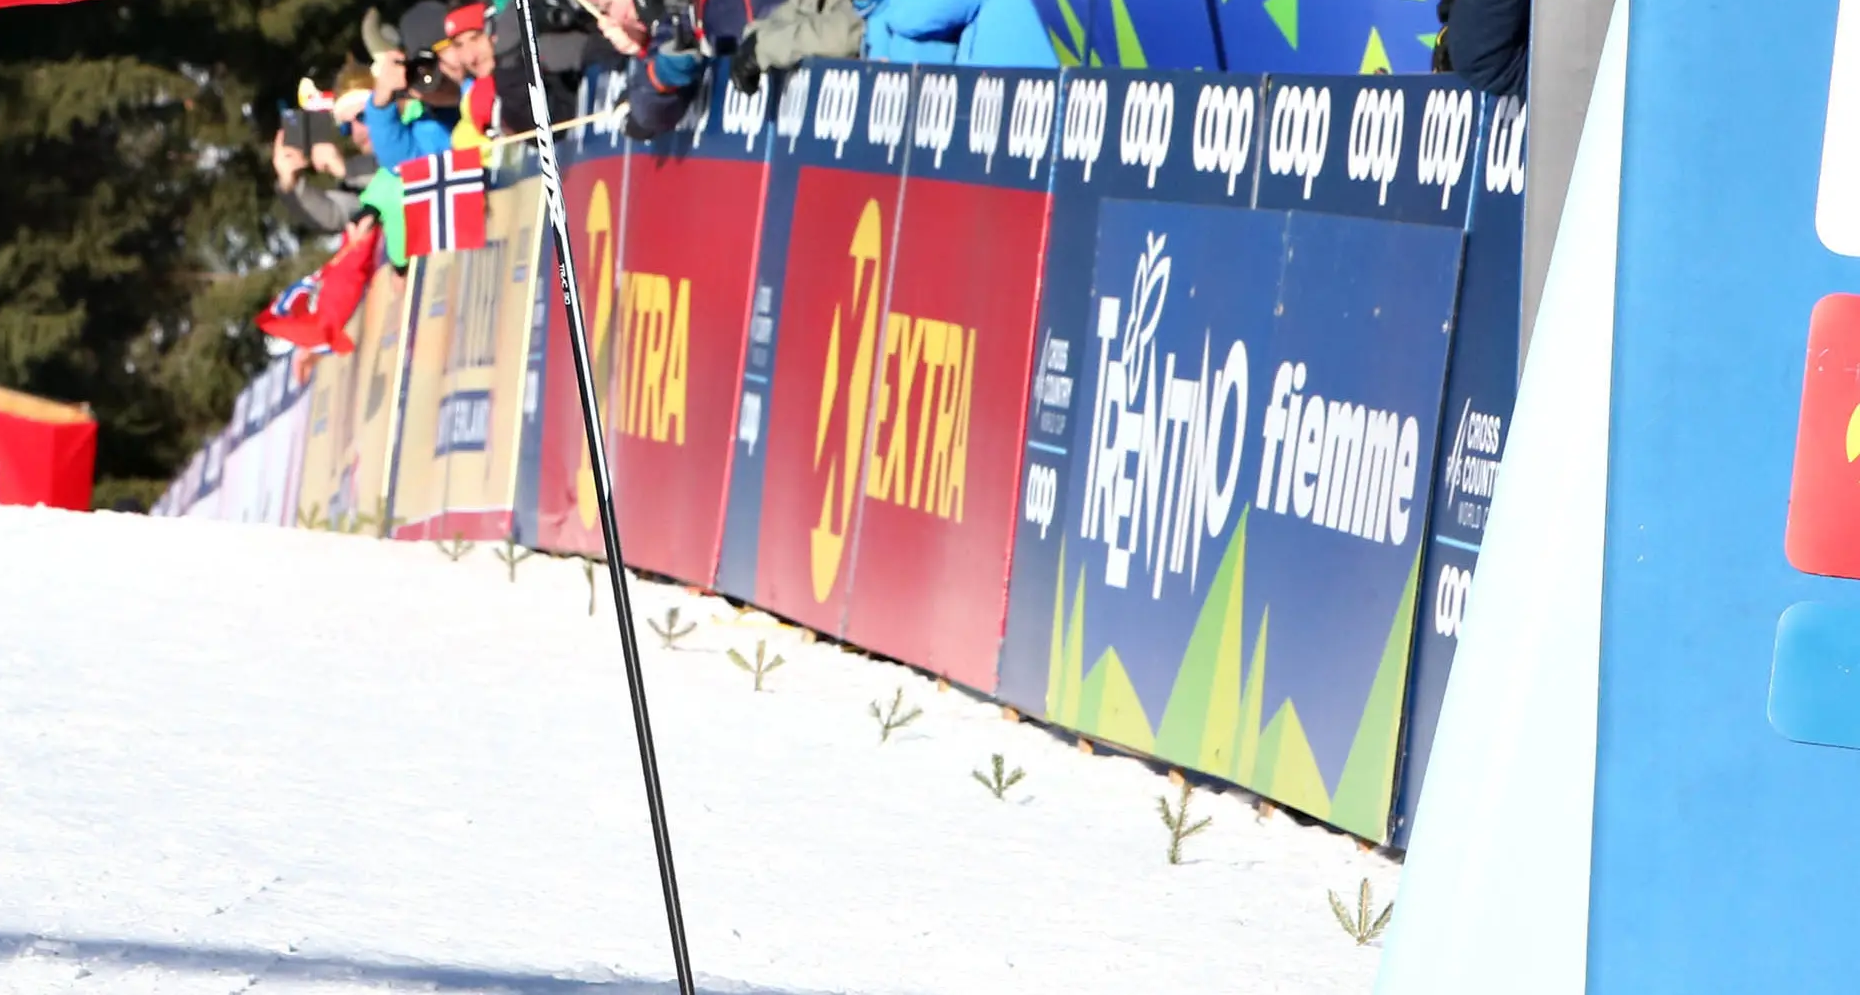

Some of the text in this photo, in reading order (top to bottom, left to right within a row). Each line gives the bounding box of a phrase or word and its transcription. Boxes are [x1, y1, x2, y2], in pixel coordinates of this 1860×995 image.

[815, 68, 860, 159] coop
[868, 71, 910, 165] coop
[915, 73, 958, 170] coop
[968, 76, 1005, 174] coop
[1008, 78, 1055, 180] coop
[1063, 78, 1108, 183] coop
[1120, 80, 1174, 188] coop
[1192, 84, 1254, 196] coop
[1269, 85, 1331, 199] coop
[1348, 88, 1405, 206] coop
[1418, 89, 1473, 210] coop
[865, 311, 977, 524] EXTRA
[1080, 296, 1419, 600] TRENTINO fiemme
[1462, 455, 1501, 498] COUNT
[1467, 412, 1501, 455] CROSS
